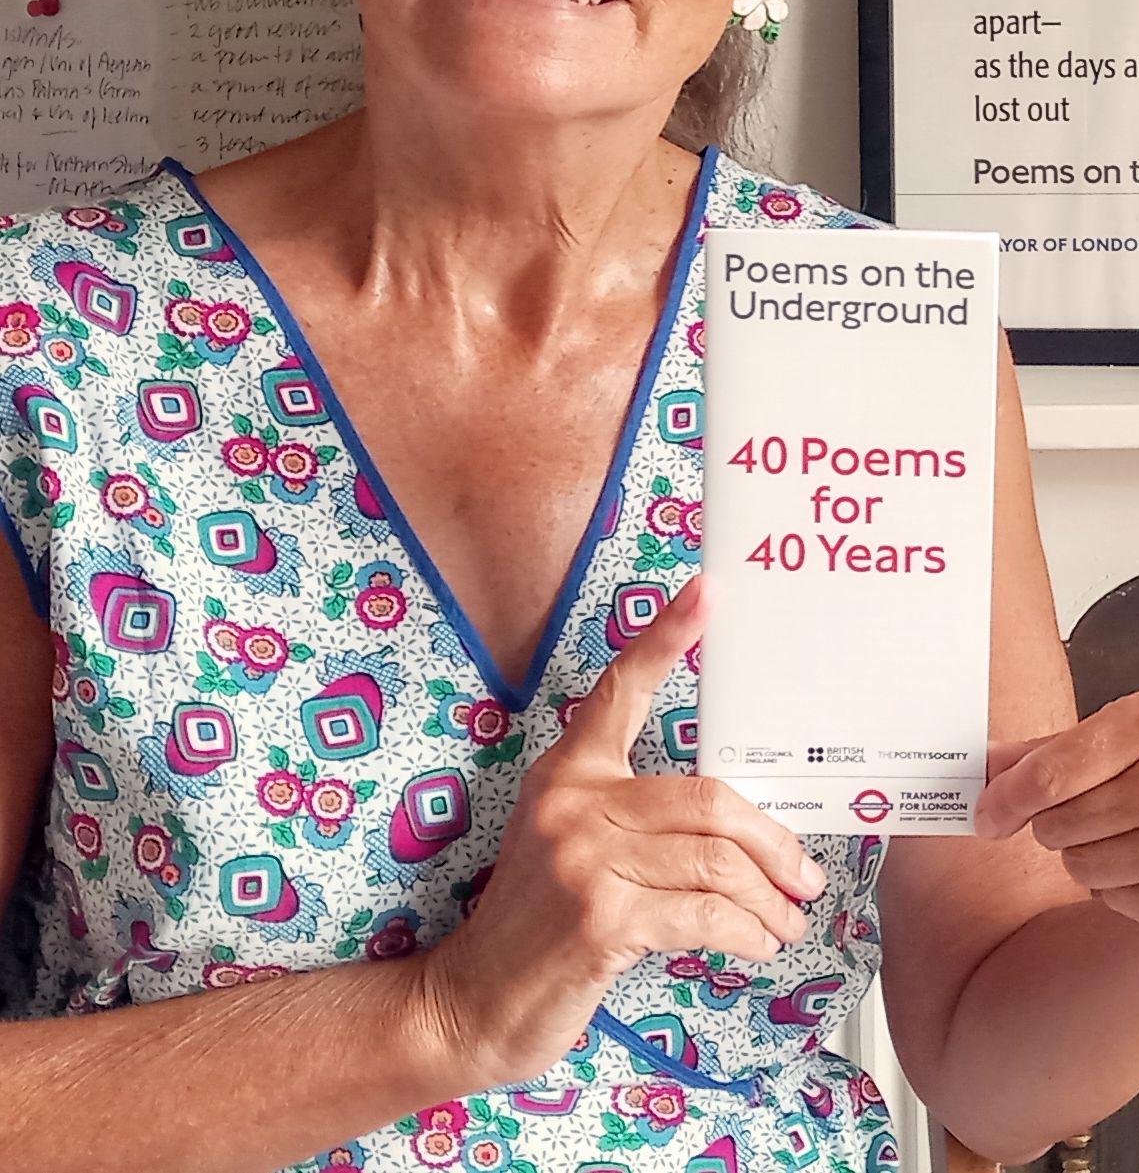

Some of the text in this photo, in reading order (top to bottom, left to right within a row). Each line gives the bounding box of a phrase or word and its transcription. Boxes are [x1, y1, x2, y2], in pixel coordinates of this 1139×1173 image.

[975, 59, 1000, 78] as
[1008, 51, 1049, 78] the
[1058, 51, 1115, 85] days
[975, 95, 1070, 121] lost out
[974, 159, 1074, 184] Poems
[1084, 165, 1120, 183] on
[999, 239, 1038, 252] YOR
[1043, 238, 1067, 251] OF
[726, 254, 974, 289] Poems on the
[731, 291, 967, 329] Underground
[727, 437, 966, 477] 40 Poems
[811, 486, 883, 524] for
[746, 534, 945, 573] 40 Years
[826, 755, 866, 763] COUNCIL
[827, 747, 864, 755] BRITISH
[757, 801, 823, 810] OF LONDON
[900, 791, 961, 801] TRANSPORT
